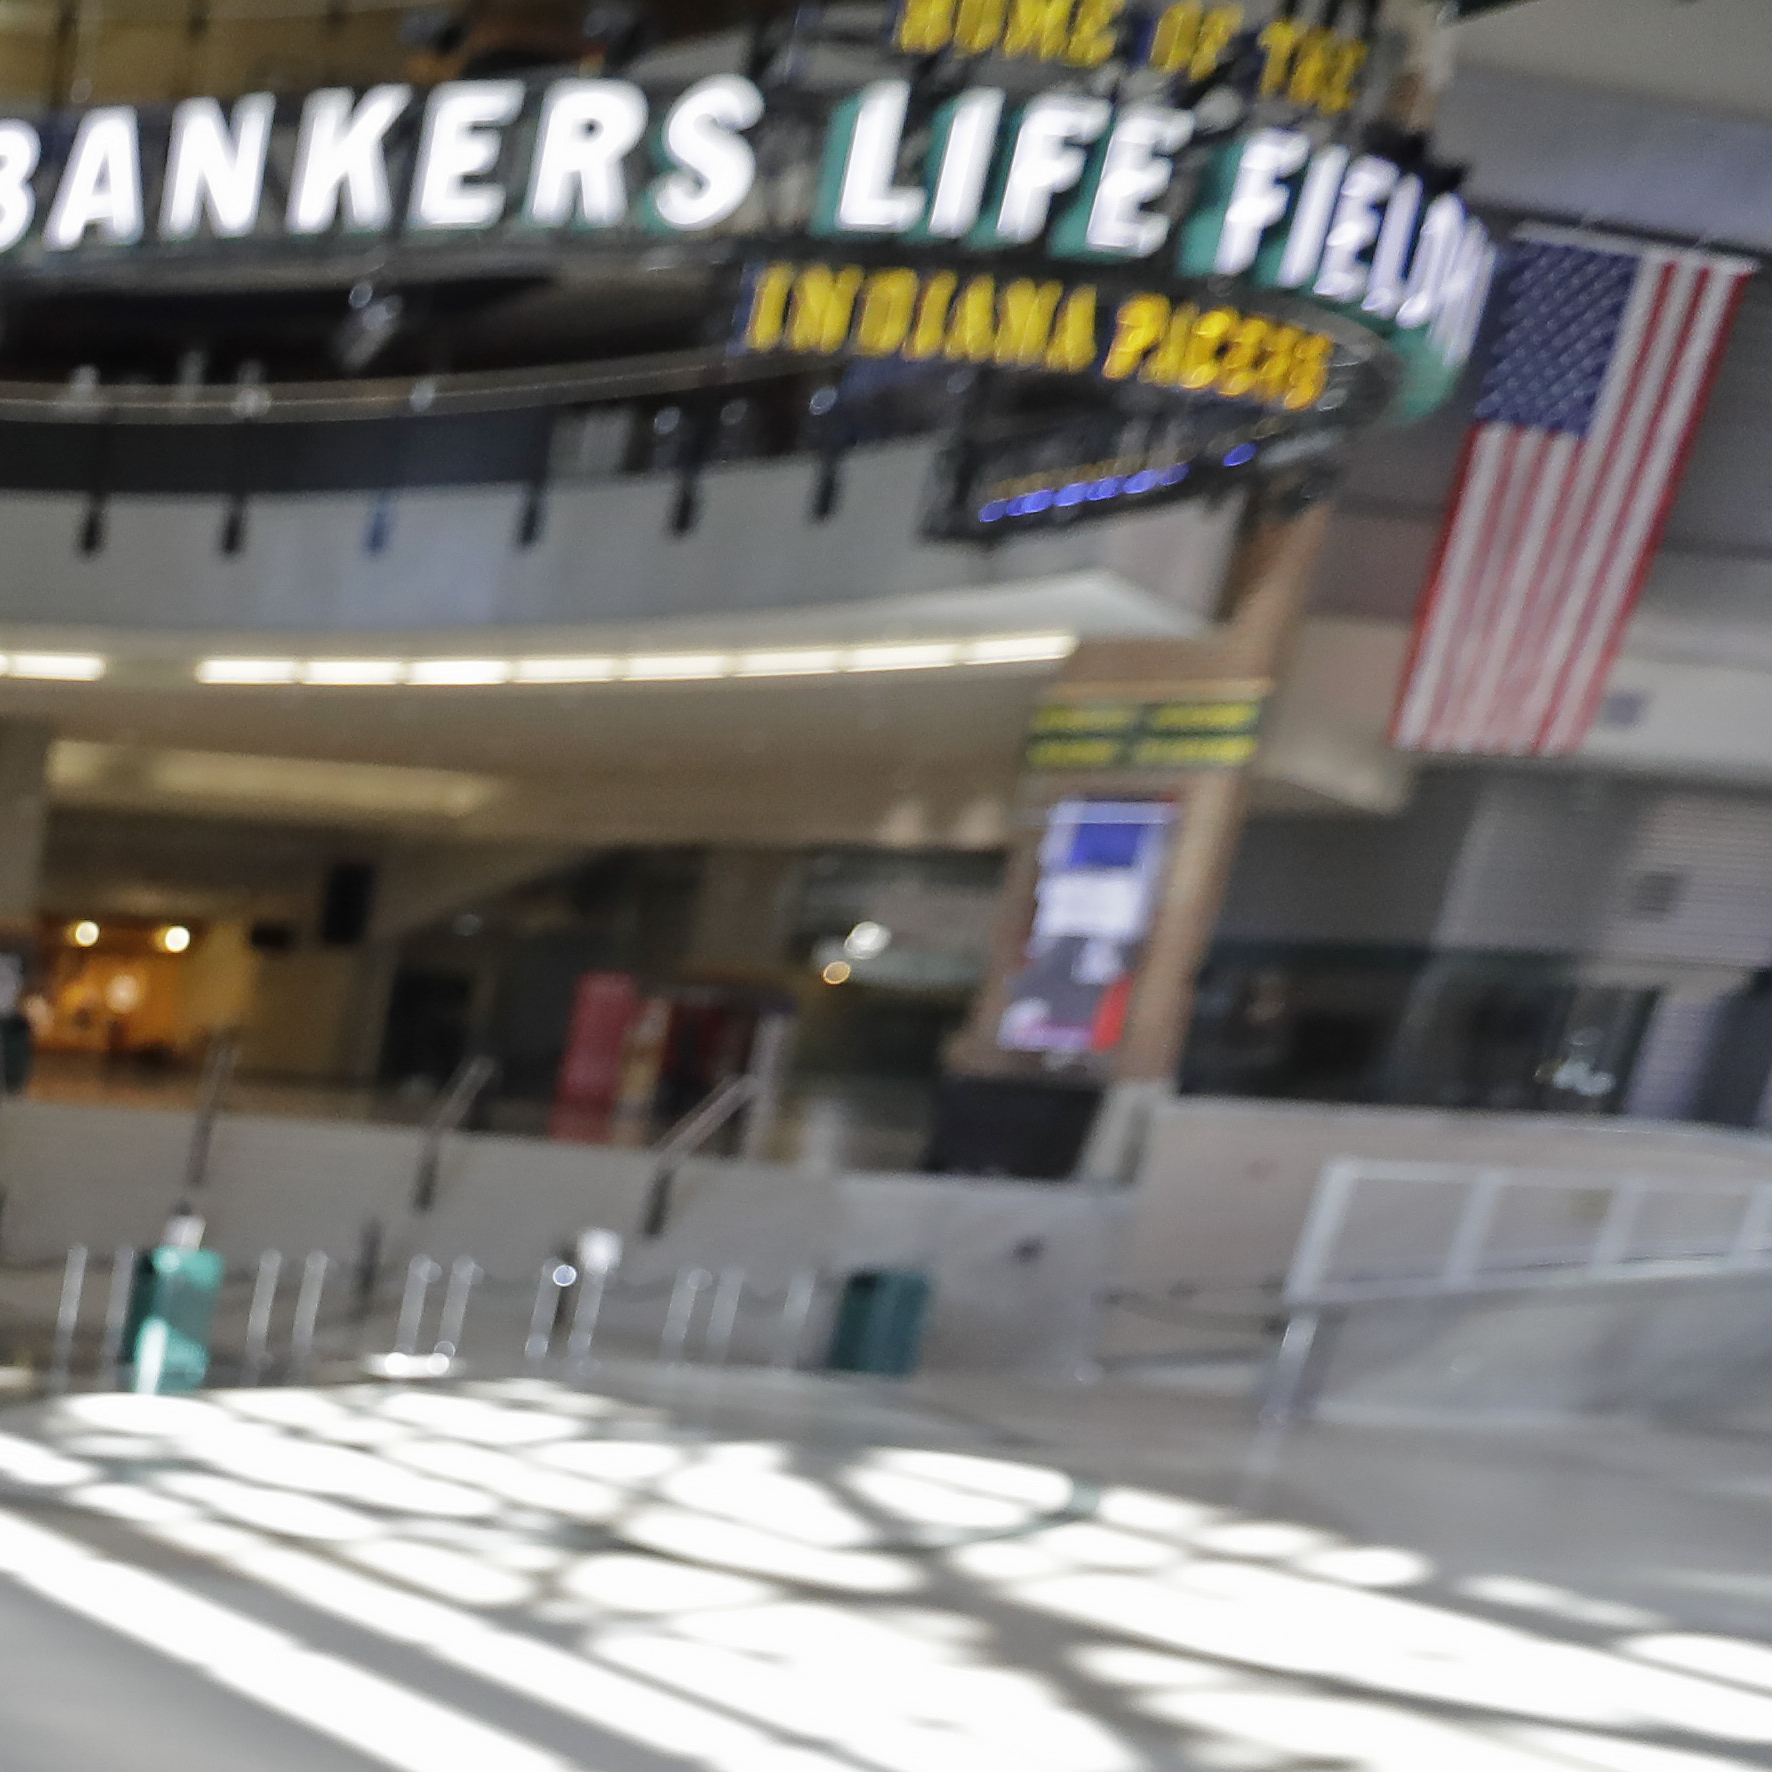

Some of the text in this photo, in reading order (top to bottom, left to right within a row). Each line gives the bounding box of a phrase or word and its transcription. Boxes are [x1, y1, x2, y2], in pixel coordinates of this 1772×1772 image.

[835, 78, 1197, 259] LIFE
[743, 262, 1333, 411] INDIANA PACERS
